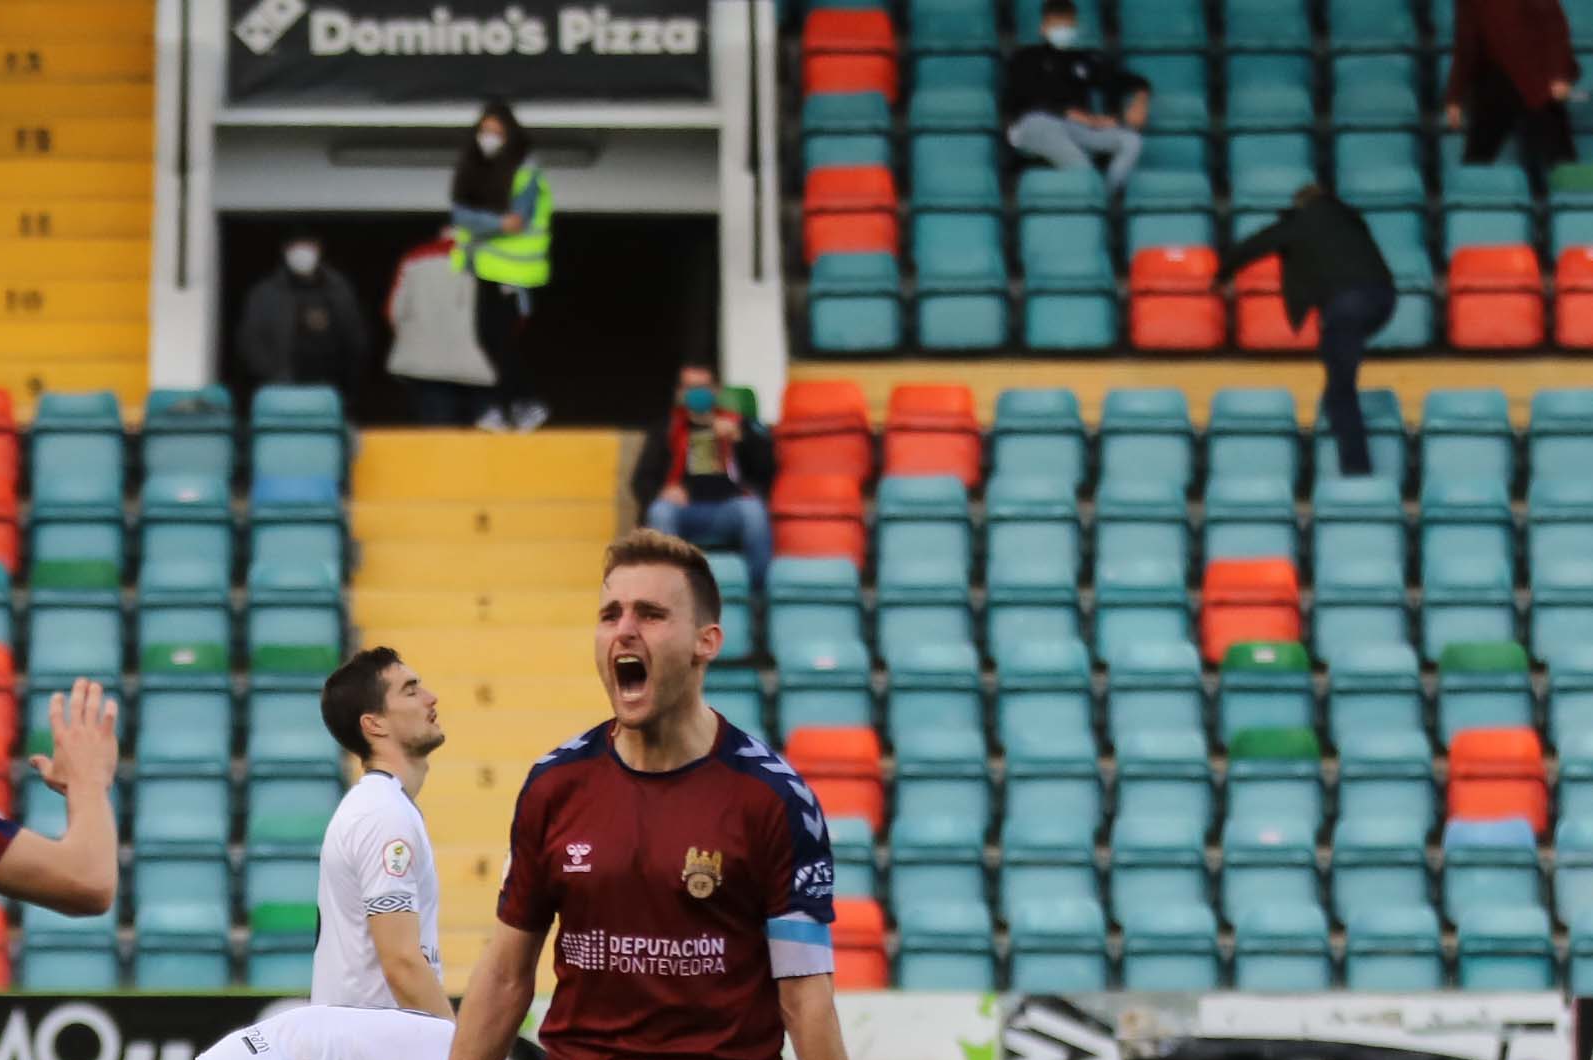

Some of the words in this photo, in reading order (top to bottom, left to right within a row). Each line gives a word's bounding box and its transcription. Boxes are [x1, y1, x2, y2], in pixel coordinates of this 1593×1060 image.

[309, 7, 548, 55] Domino's
[558, 8, 700, 54] Pizza
[608, 932, 726, 958] DEPUTACIÓN
[608, 955, 727, 977] PONTEVEDRA
